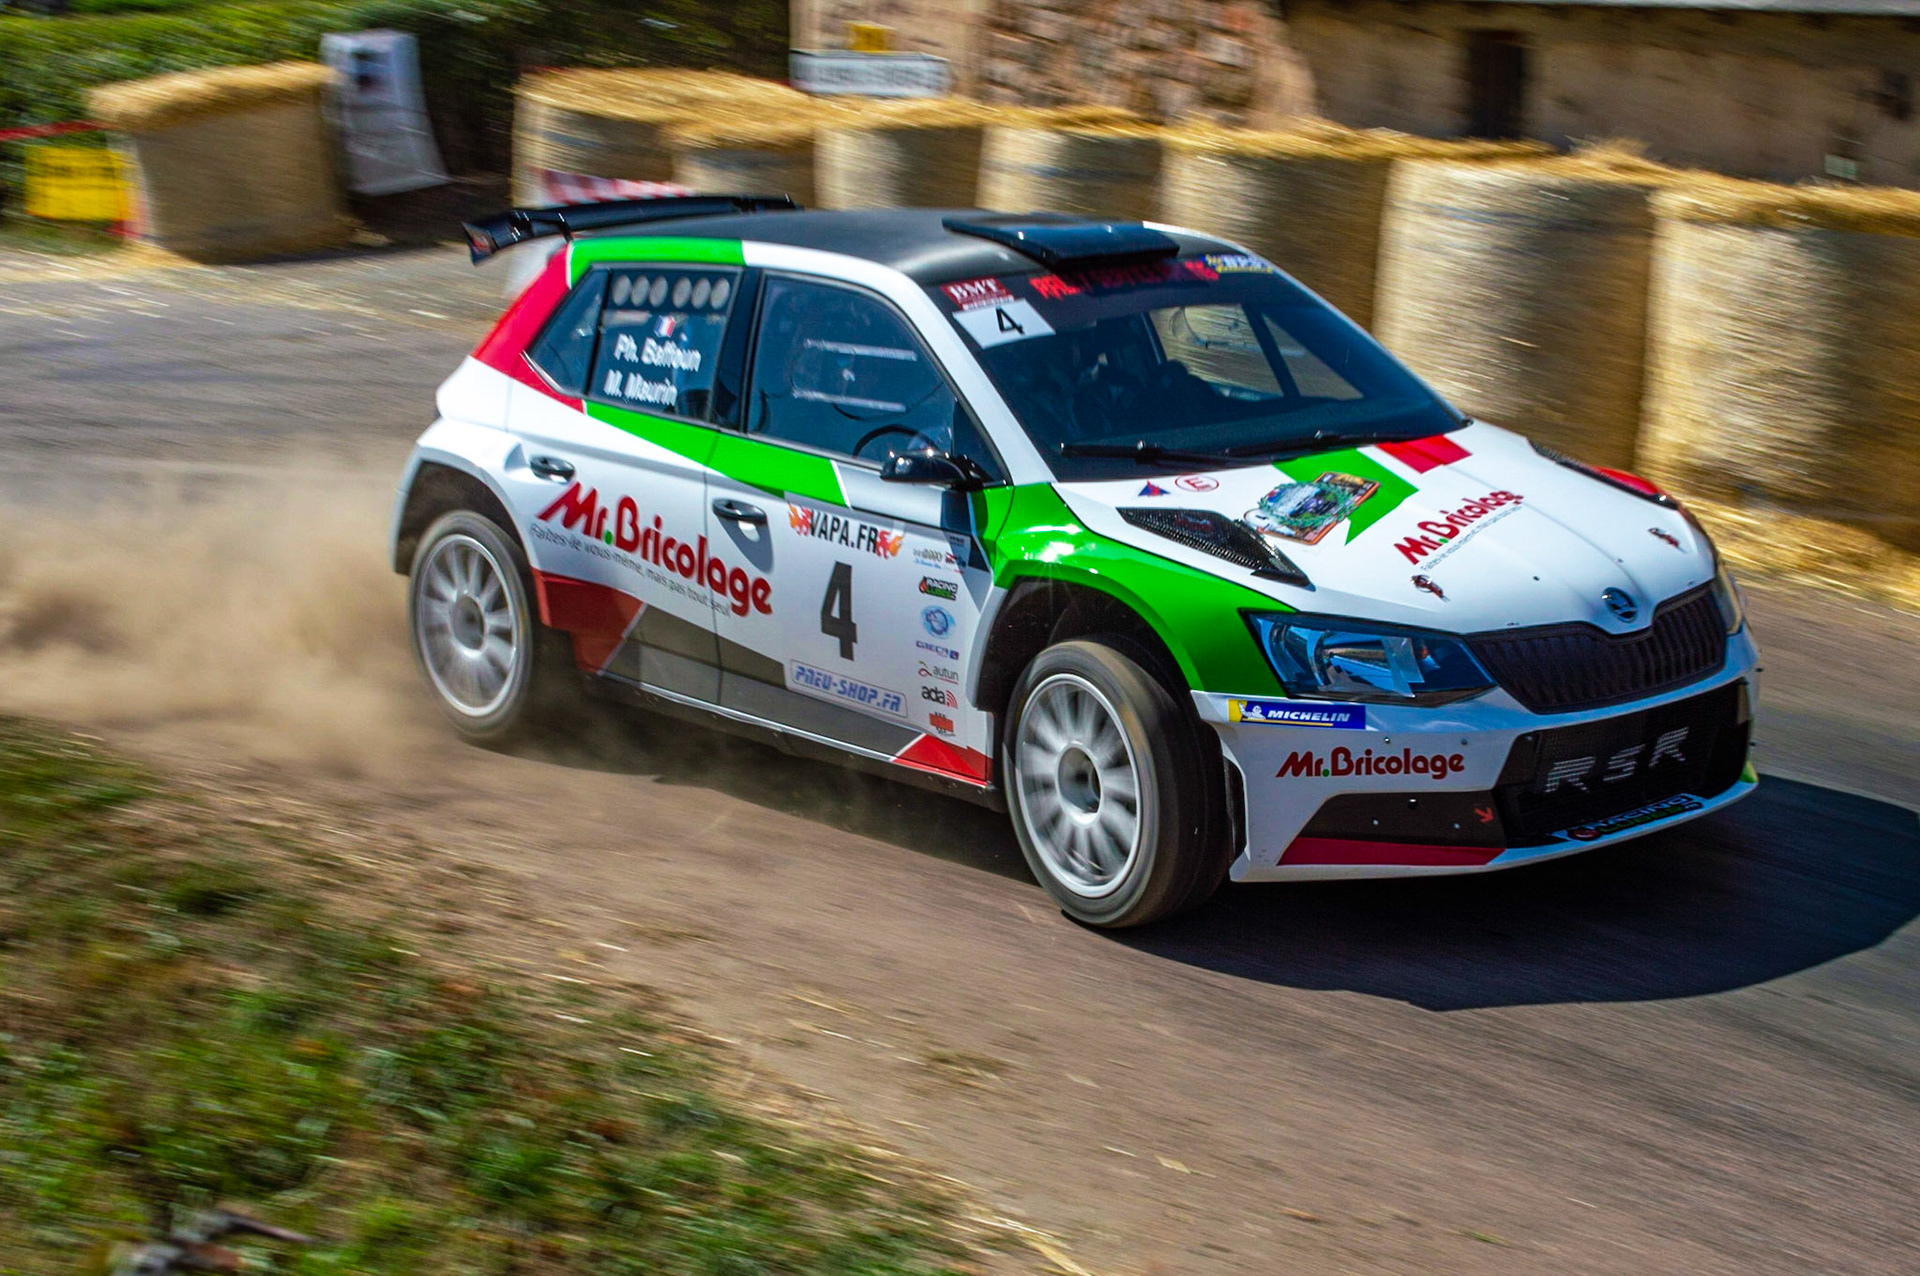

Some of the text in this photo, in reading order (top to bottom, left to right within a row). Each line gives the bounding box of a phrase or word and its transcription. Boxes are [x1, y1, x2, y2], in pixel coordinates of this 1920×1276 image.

[995, 307, 1025, 335] 4
[810, 508, 879, 554] VAPA.FR
[1393, 490, 1524, 565] Mr.Bricolag
[535, 480, 773, 618] Mr.Bricolage
[821, 560, 858, 661] 4
[795, 665, 902, 713] PNEU-SHOP.FR
[932, 665, 959, 682] autun
[921, 685, 945, 706] ada
[1267, 709, 1351, 723] MICHELIN
[1275, 746, 1465, 780] Mr.Bricolage
